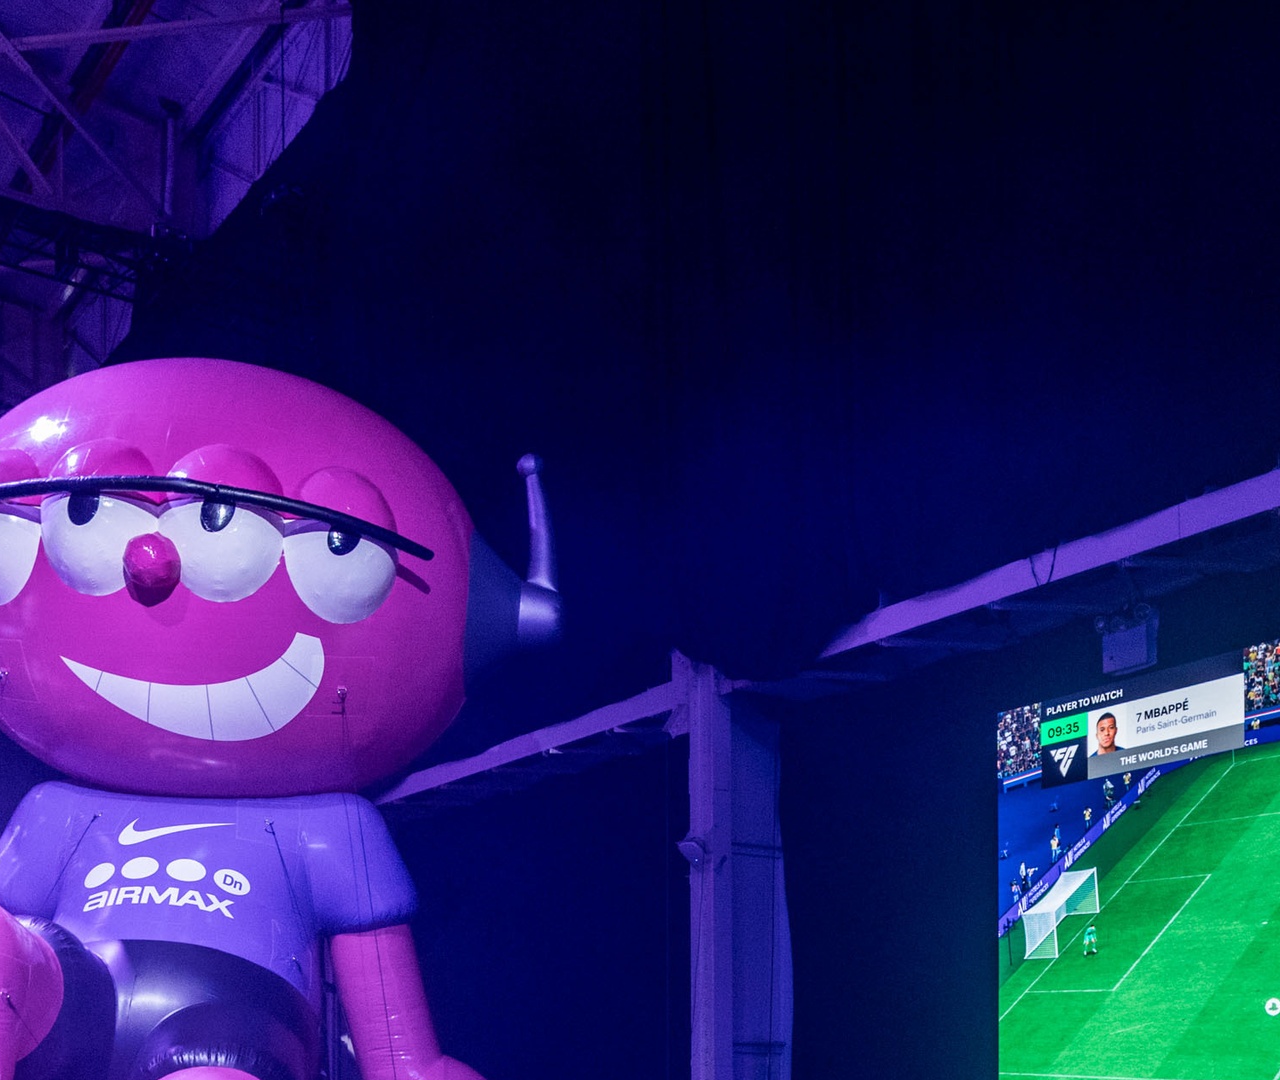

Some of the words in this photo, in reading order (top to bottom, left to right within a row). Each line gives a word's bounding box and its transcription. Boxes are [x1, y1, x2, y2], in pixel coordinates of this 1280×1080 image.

[1046, 701, 1078, 717] PLAYER
[1079, 698, 1090, 708] TO
[1090, 689, 1123, 705] WATCH
[1136, 712, 1142, 722] 7
[1144, 699, 1189, 720] MBAPPÉ
[1048, 722, 1080, 739] 09:35
[1136, 724, 1156, 735] Paris
[1157, 709, 1217, 731] Saint-Germain
[1120, 756, 1137, 766] THE
[1138, 746, 1180, 763] WORLD'S
[1180, 740, 1208, 754] GAME
[223, 874, 243, 890] Dn
